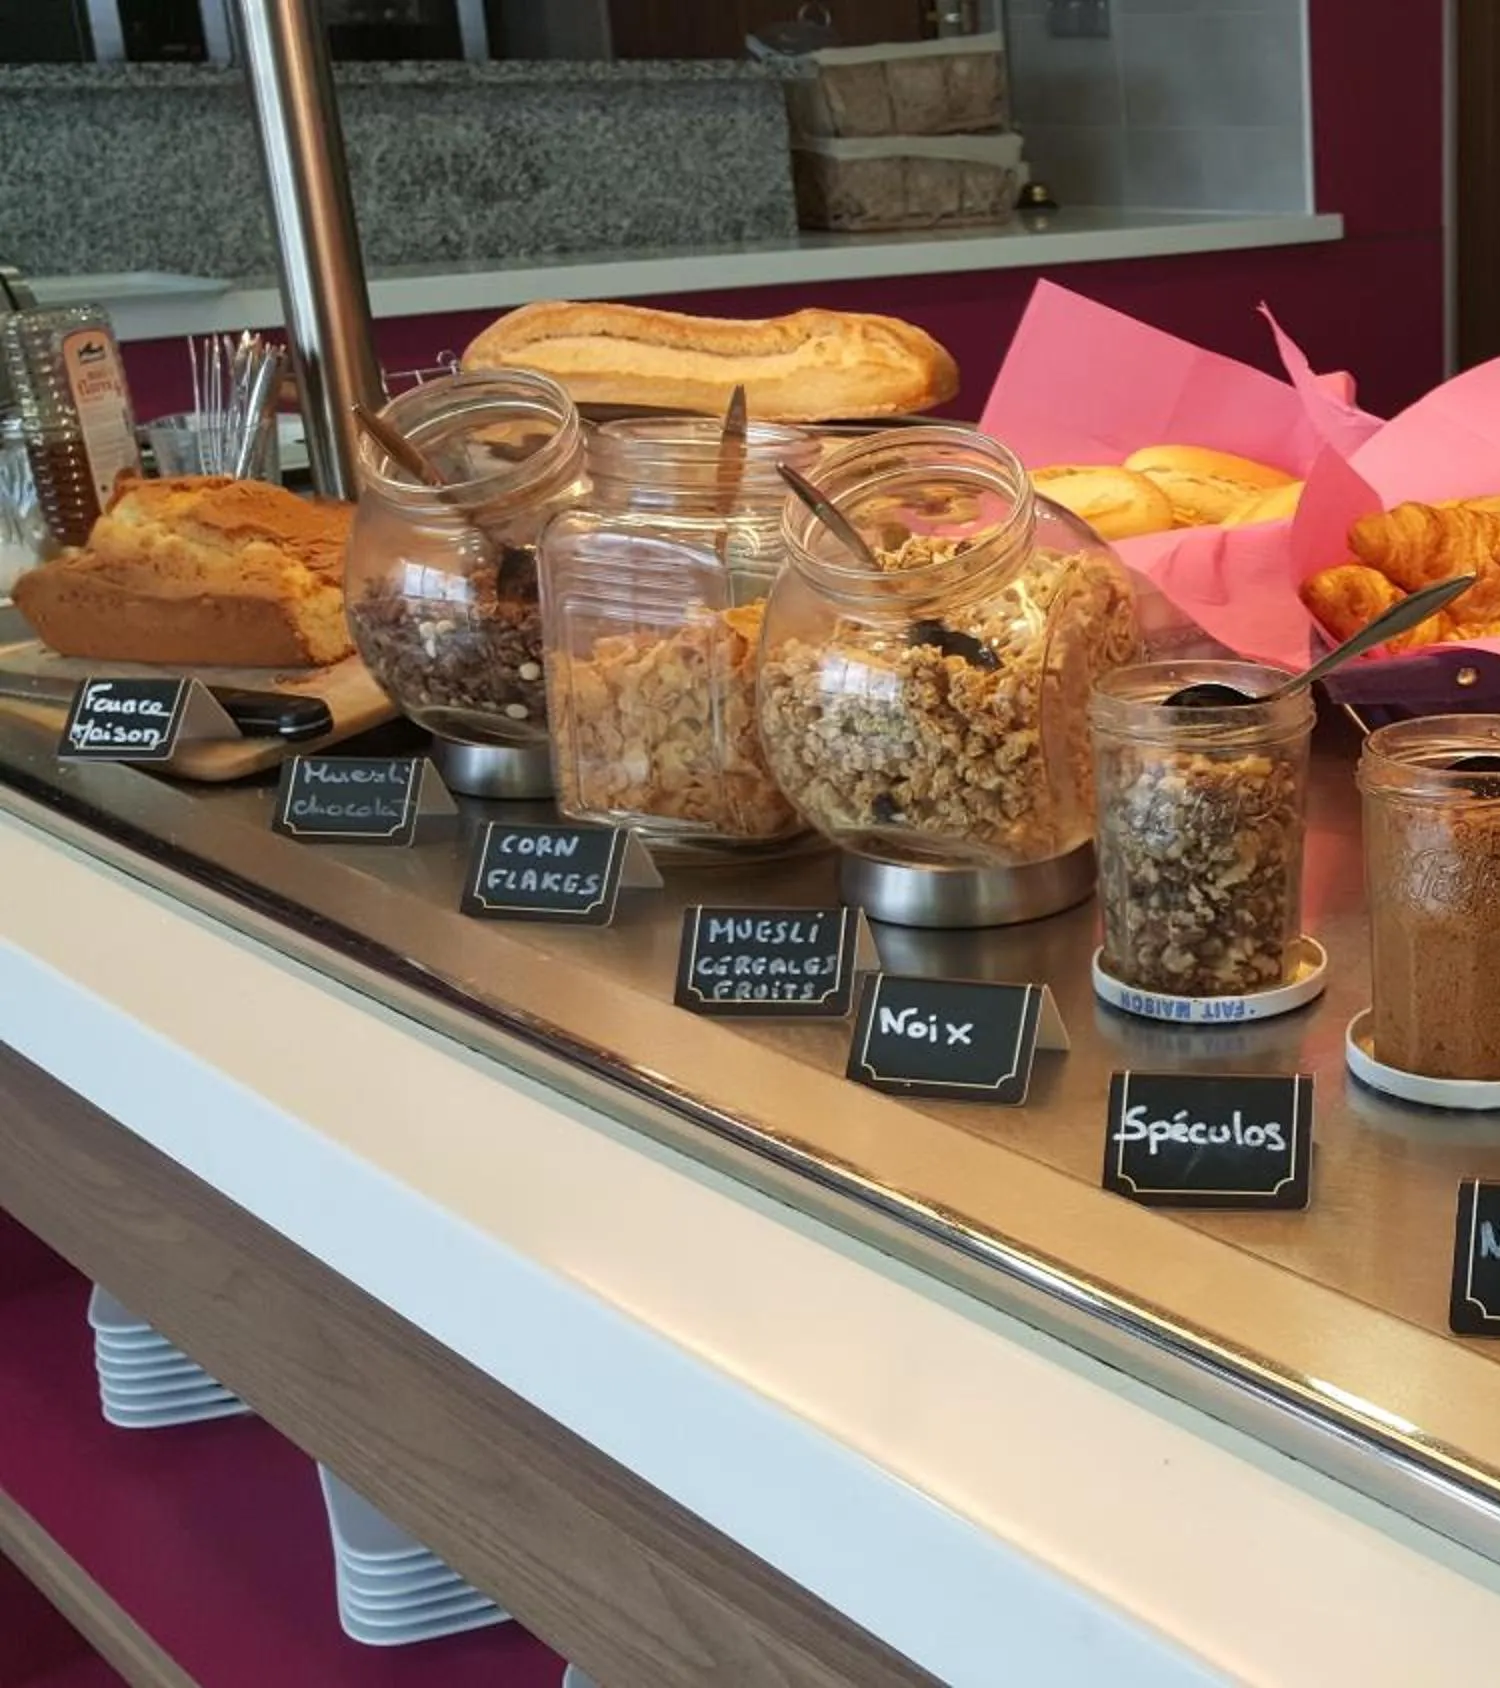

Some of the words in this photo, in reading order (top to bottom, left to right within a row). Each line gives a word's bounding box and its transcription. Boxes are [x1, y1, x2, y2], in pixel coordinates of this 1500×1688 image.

[71, 718, 160, 748] Maison
[499, 834, 580, 858] CORN
[487, 868, 601, 896] FLAKES
[1119, 990, 1192, 1019] MAISON
[1202, 1000, 1246, 1019] FAIT
[878, 1005, 974, 1047] Noix
[1112, 1105, 1287, 1156] Spéculos
